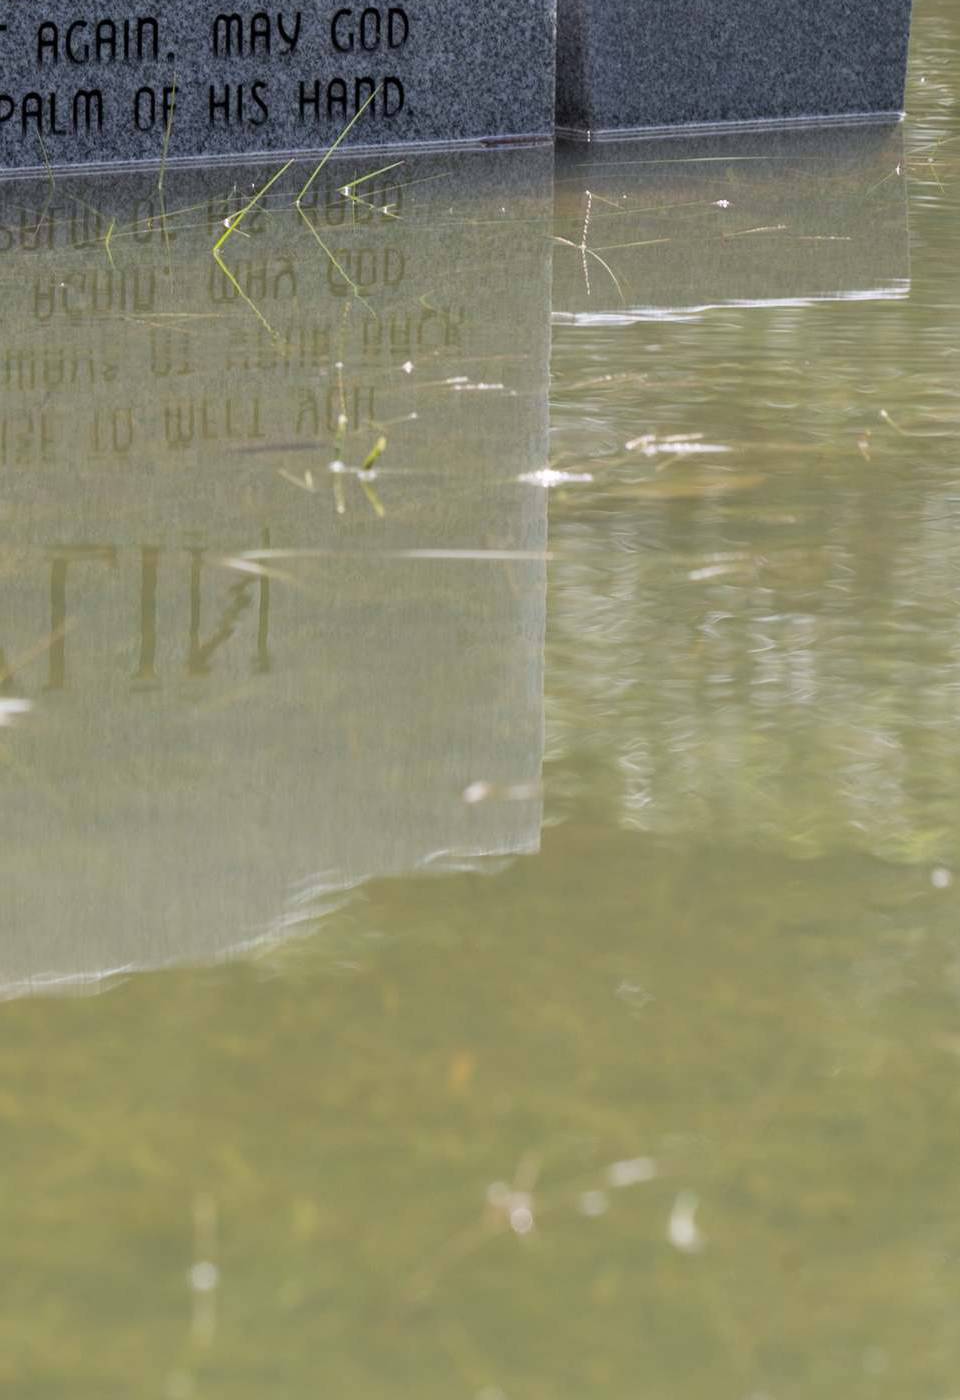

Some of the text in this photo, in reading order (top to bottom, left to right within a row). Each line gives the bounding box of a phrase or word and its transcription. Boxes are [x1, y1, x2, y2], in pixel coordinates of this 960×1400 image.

[37, 7, 410, 65] AGAIN. MAY GOD
[134, 86, 178, 132] OF
[208, 81, 269, 127] HIS
